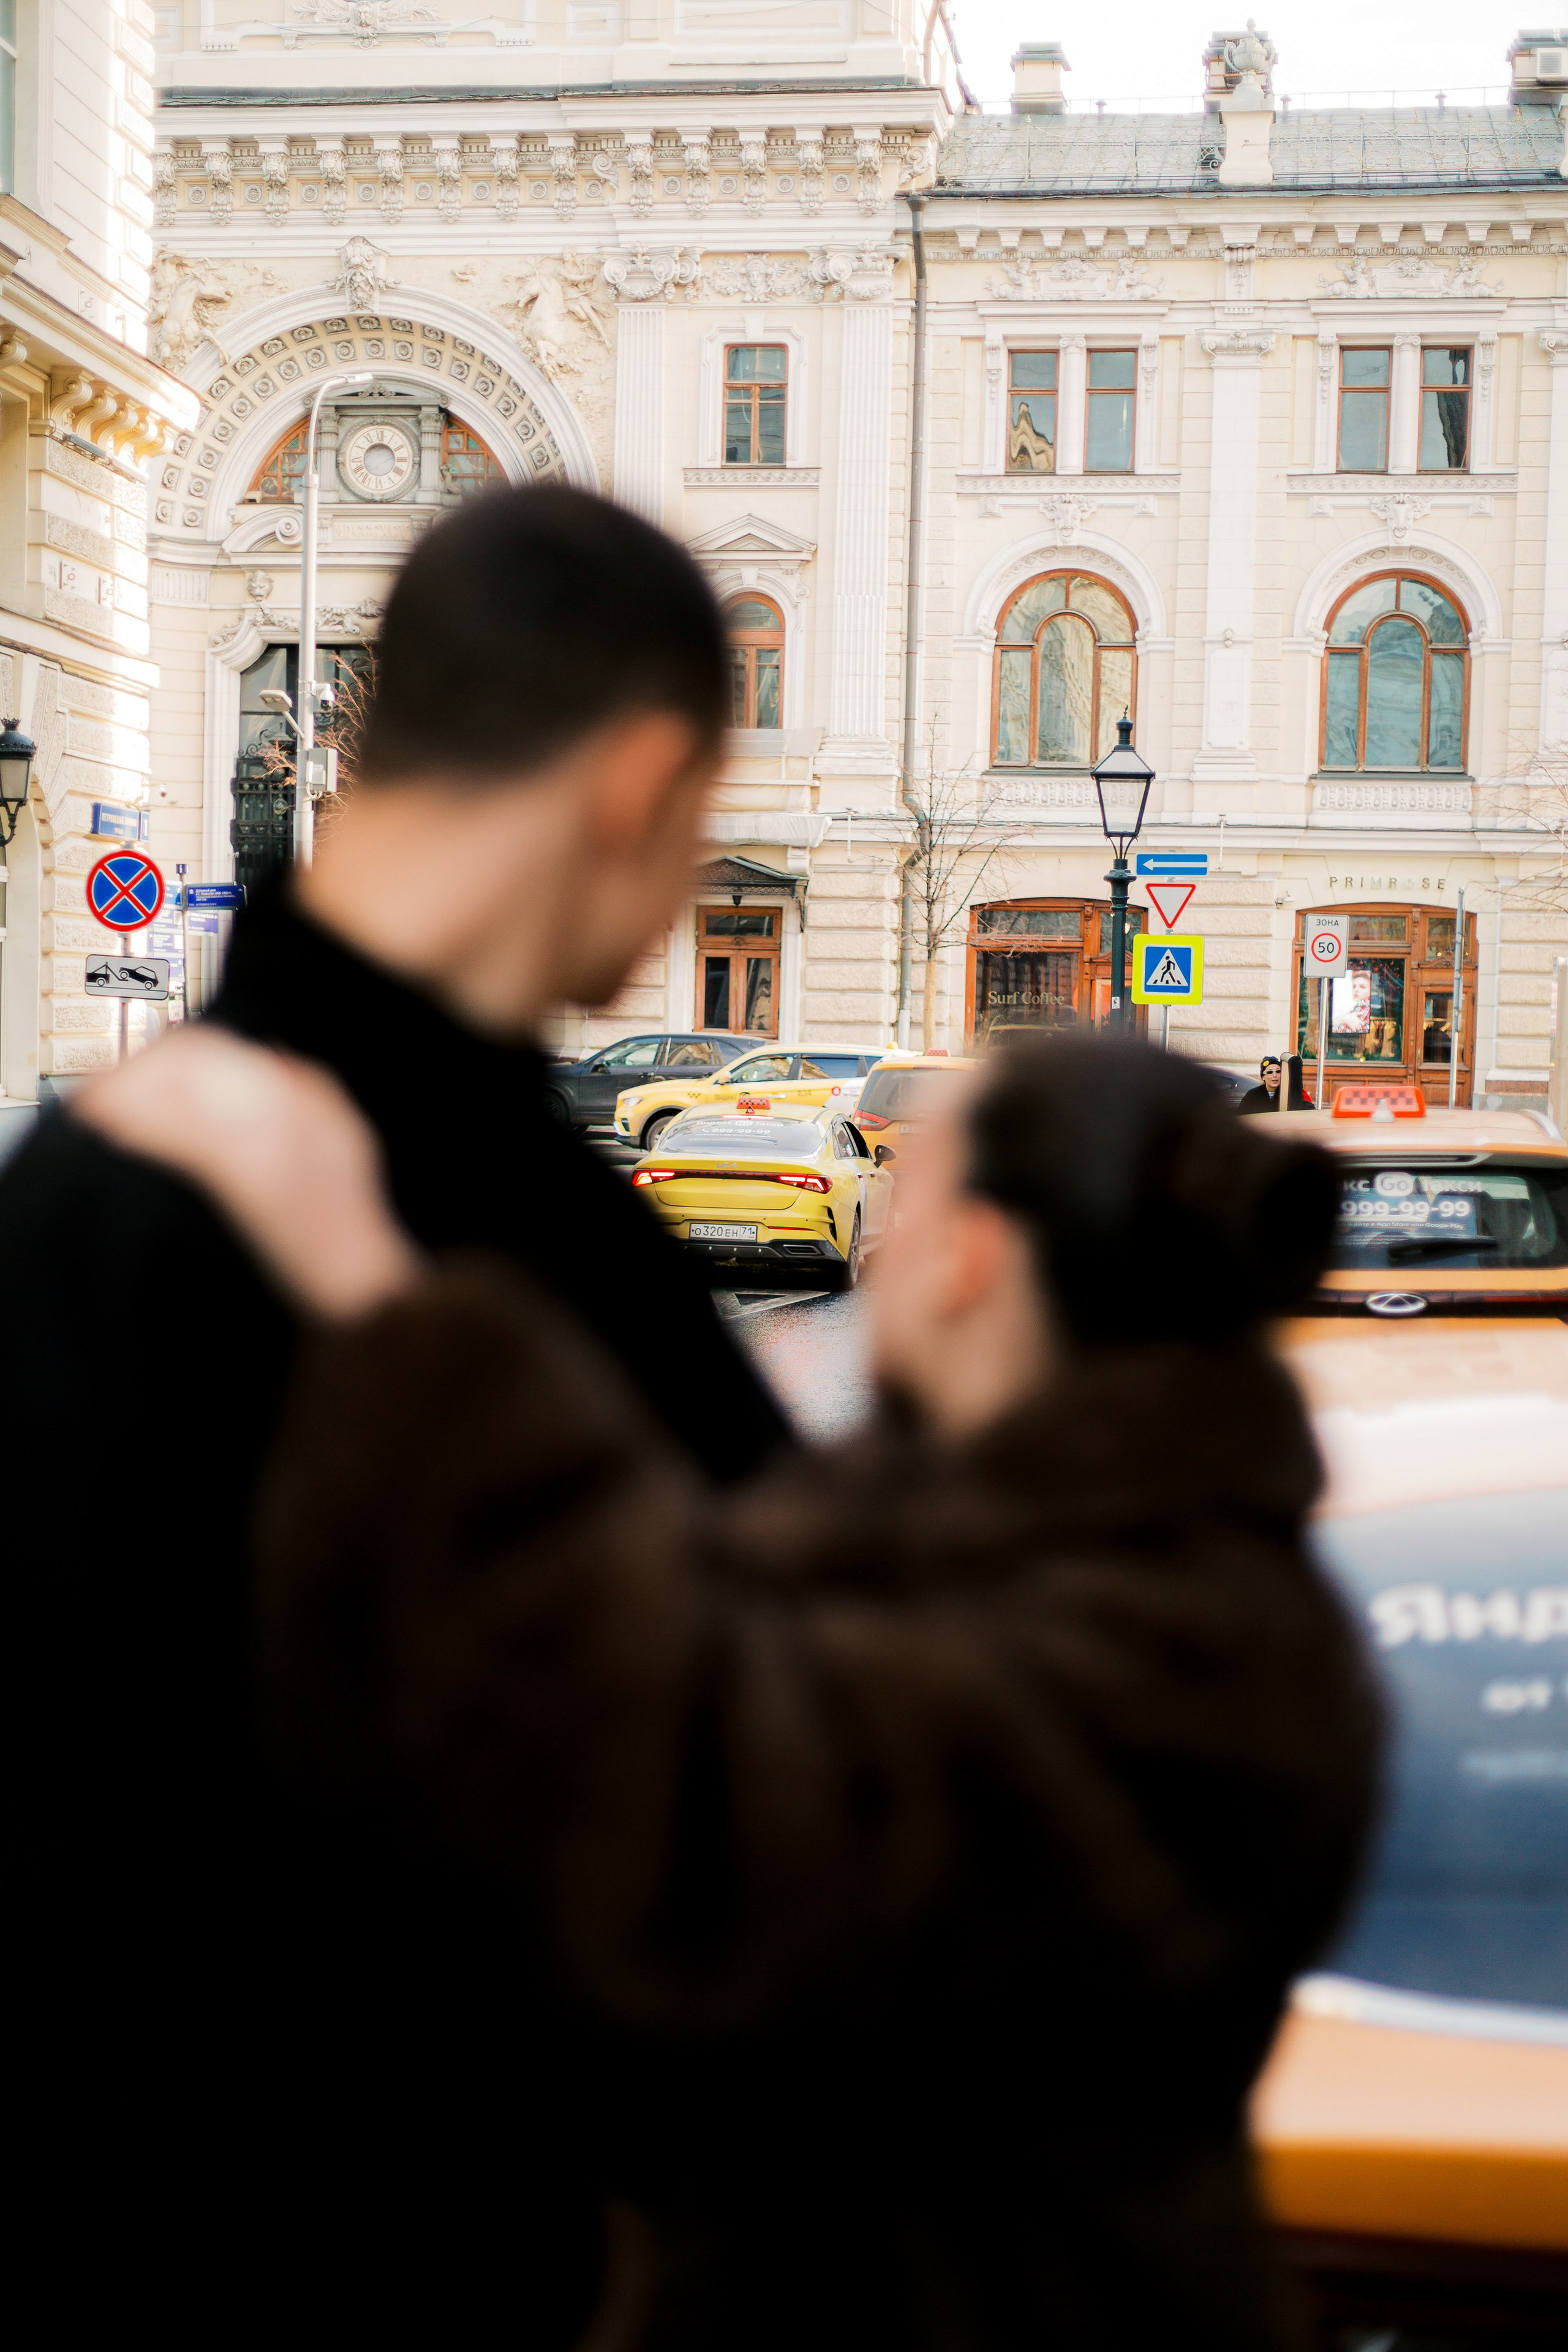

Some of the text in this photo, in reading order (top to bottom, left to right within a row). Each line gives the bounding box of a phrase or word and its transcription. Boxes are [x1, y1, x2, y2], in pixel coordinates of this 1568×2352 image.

[144, 818, 148, 836] 1
[1318, 942, 1335, 953] 50
[989, 990, 1065, 1005] Surf Coffee
[1381, 1176, 1409, 1191] Go
[1342, 1200, 1471, 1217] 999-99-99
[1370, 1585, 1568, 1646] Янд
